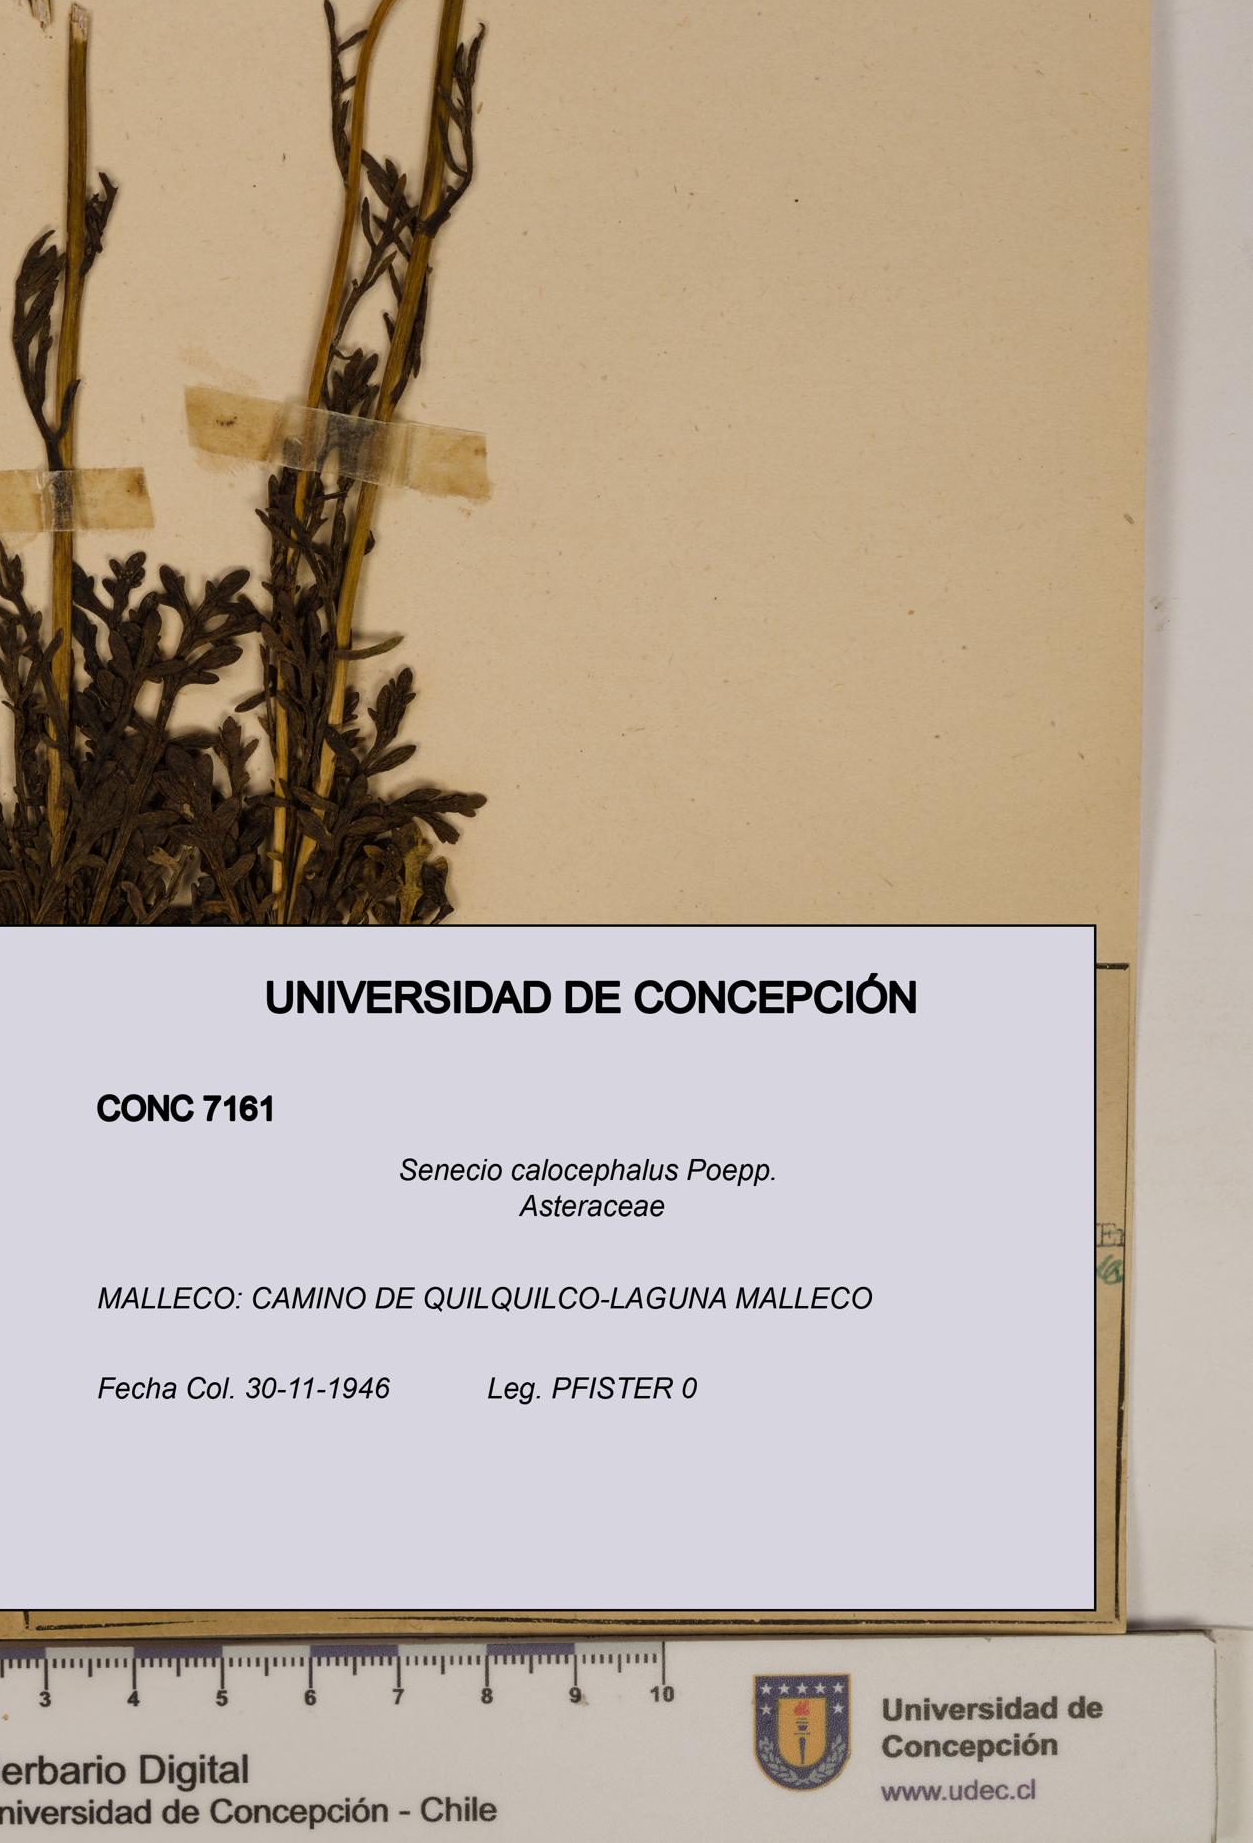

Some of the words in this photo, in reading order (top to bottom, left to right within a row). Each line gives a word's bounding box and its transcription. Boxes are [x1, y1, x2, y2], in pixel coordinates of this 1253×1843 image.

[38, 1690, 52, 1708] 3
[126, 1689, 141, 1707] 4
[215, 1689, 229, 1707] 5
[304, 1688, 317, 1706] 6
[392, 1687, 405, 1705] 7
[480, 1687, 494, 1705] 8
[568, 1686, 583, 1704] 9
[650, 1685, 675, 1703] 10
[882, 1695, 1058, 1722] Universidad
[1067, 1695, 1104, 1720] de
[881, 1732, 1058, 1763] Concepción
[139, 1753, 249, 1793] Digital
[880, 1778, 1037, 1802] www.udec.cl
[162, 1798, 200, 1825] de
[209, 1797, 390, 1830] Concepción
[420, 1796, 498, 1823] Chile
